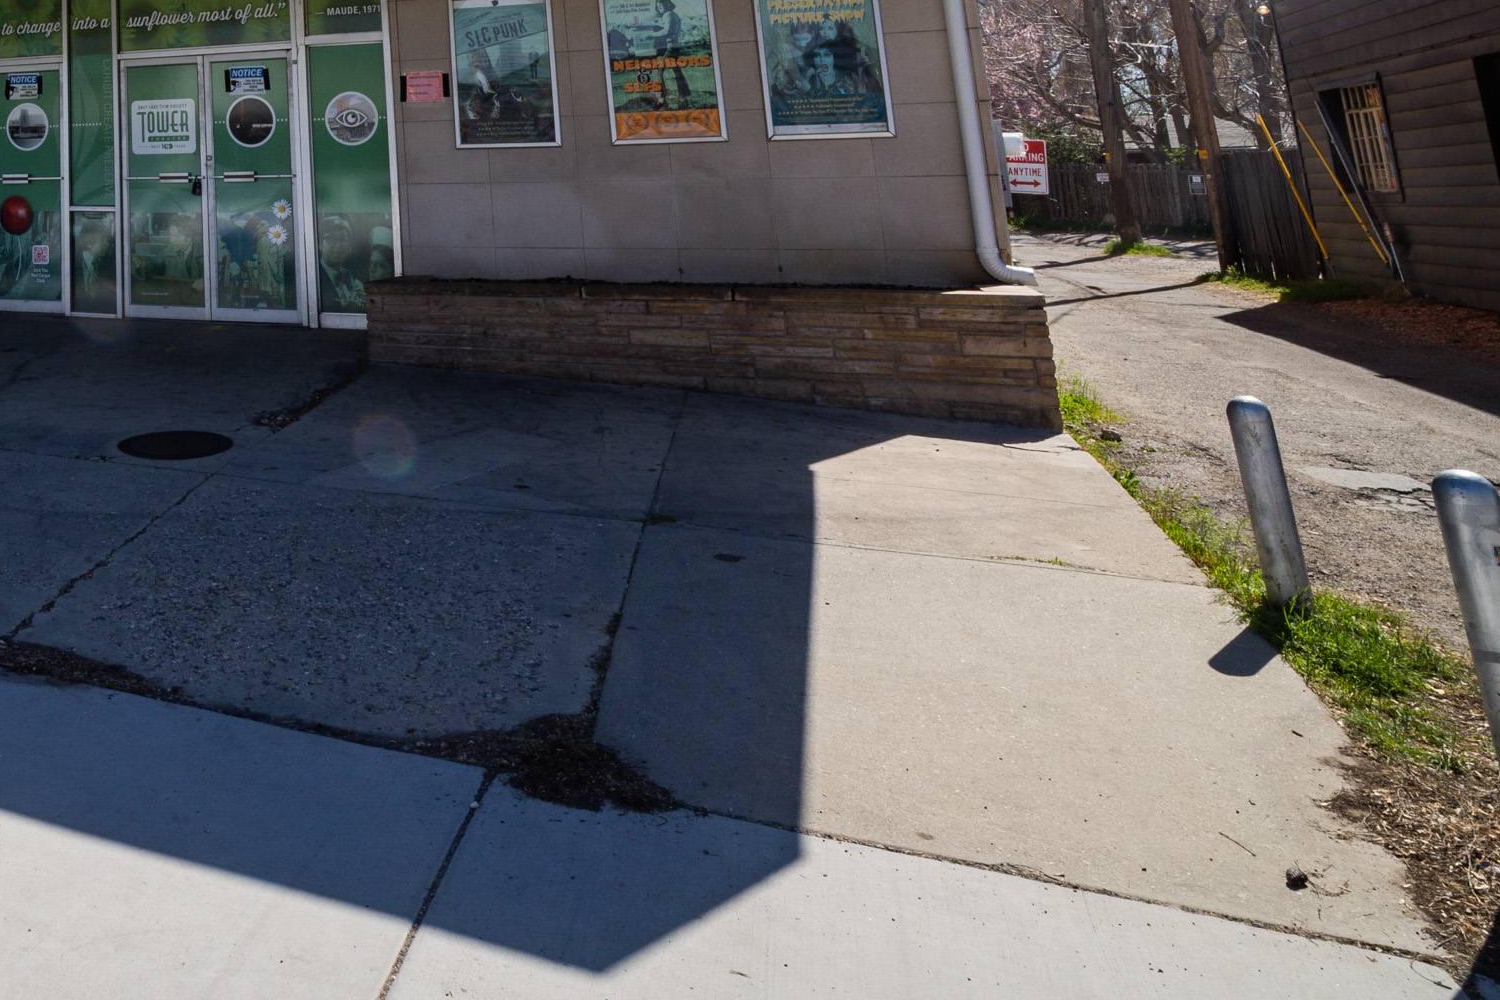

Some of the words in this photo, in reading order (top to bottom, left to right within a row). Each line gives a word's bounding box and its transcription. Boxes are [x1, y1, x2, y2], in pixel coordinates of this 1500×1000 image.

[326, 6, 360, 16] MAUDE,
[362, 4, 380, 14] 1971
[770, 11, 825, 27] PICTURE
[828, 9, 864, 23] SHOW
[1, 24, 14, 36] to
[16, 22, 60, 38] change
[72, 18, 98, 30] into
[100, 18, 110, 28] a
[126, 11, 195, 31] sunflower
[198, 8, 232, 22] most
[235, 4, 251, 24] of
[466, 26, 491, 48] SLC
[493, 18, 528, 42] PUNK
[613, 56, 711, 71] NEIGHBORS
[102, 59, 112, 98] EXHIBIT
[232, 69, 262, 77] NOTICE
[637, 68, 652, 84] &
[624, 81, 662, 94] SLFS
[104, 103, 113, 142] CREATE
[137, 110, 189, 142] TOWER
[104, 146, 114, 199] PRESERVE
[1008, 168, 1042, 176] ANYTIME
